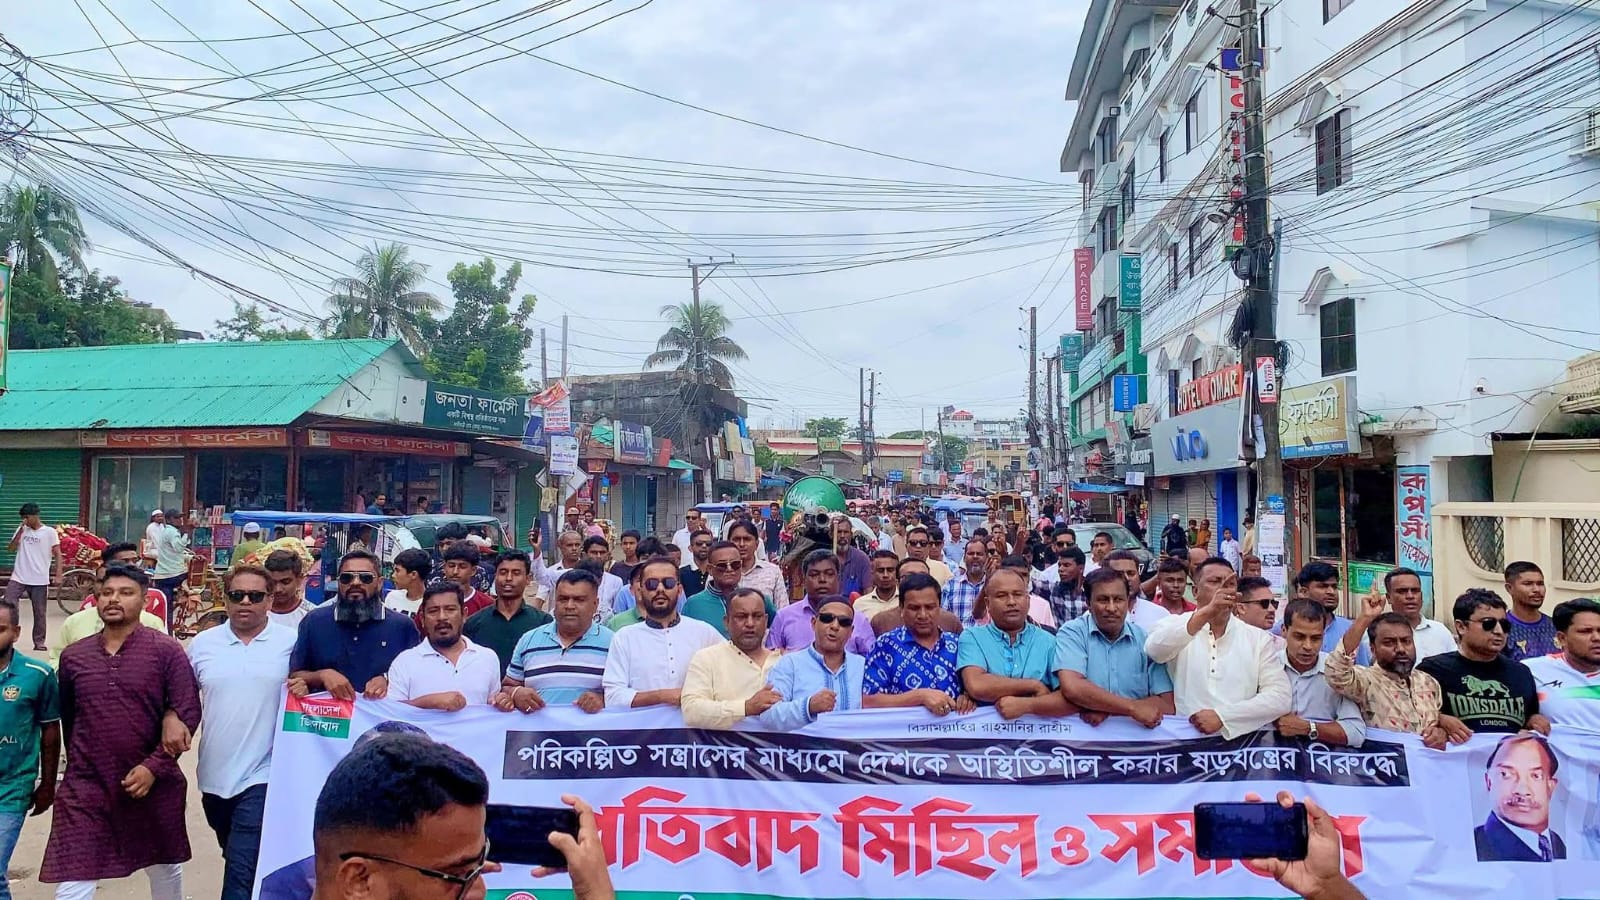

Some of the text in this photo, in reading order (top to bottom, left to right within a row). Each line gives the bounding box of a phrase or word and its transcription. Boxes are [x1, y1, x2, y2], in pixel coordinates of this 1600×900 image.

[1080, 263, 1088, 310] PALACE
[434, 390, 519, 417] জনতা ফার্মেসী
[1177, 382, 1202, 412] HOTEL
[1210, 370, 1238, 401] OMAR
[110, 428, 283, 443] জনতা ফার্মেসী
[336, 434, 390, 447] জনতা
[1447, 691, 1525, 720] LONSDALE
[1480, 719, 1508, 727] LONDON
[517, 738, 1399, 781] পরিকল্পিত সন্ত্রাসের মাধ্যমে দেশকে অস্থিতিশীল করার ষড়যন্ত্রের বিরুদ্ধে
[833, 796, 1039, 881] মিছিল
[1050, 826, 1089, 867] ও
